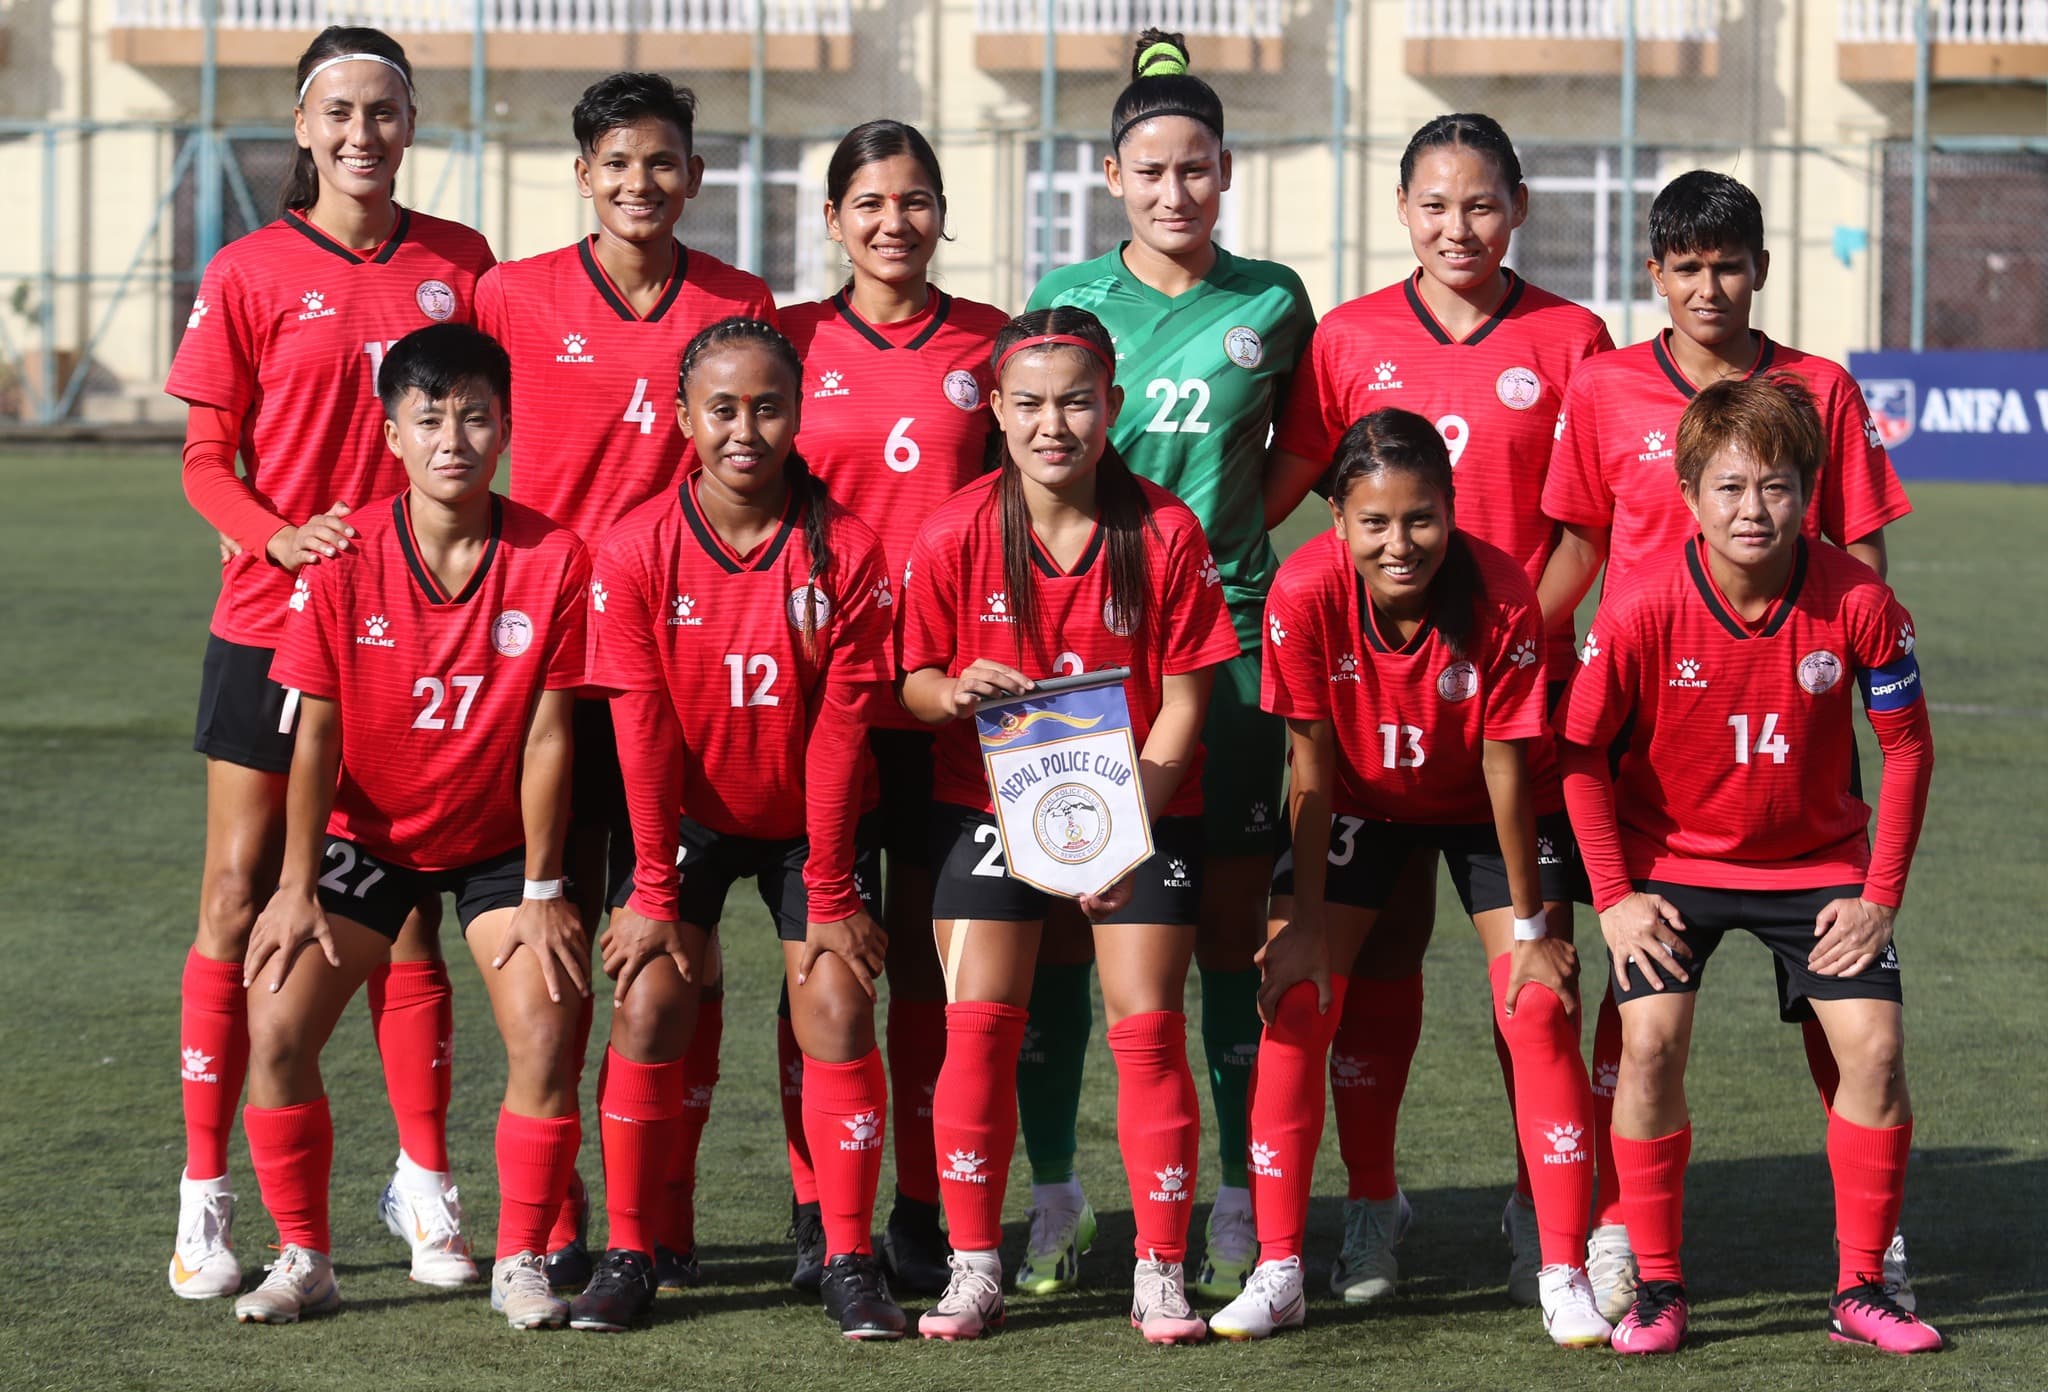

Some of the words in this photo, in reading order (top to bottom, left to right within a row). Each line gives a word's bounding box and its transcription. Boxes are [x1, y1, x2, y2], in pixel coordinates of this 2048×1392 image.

[298, 308, 337, 321] KELME
[362, 339, 400, 398] 1
[556, 355, 594, 363] KELME
[623, 379, 656, 434] 4
[814, 388, 850, 398] KELME
[1145, 378, 1211, 434] 22
[1368, 381, 1403, 391] KELME
[1920, 387, 2031, 434] ANFA
[884, 418, 920, 472] 6
[1434, 414, 1469, 470] 9
[1638, 449, 1673, 462] KELME
[357, 637, 395, 647] KELME
[667, 616, 703, 626] KELME
[411, 675, 484, 730] 27
[723, 654, 779, 708] 12
[1669, 678, 1708, 689] KELME
[1871, 670, 1918, 696] CAPTAIN
[1377, 723, 1425, 769] 13
[1727, 713, 1790, 765] 14
[998, 763, 1042, 804] NEPAL
[1040, 750, 1091, 778] POLICE
[1094, 754, 1132, 786] CLUB
[1055, 788, 1082, 797] POLICE
[971, 823, 1006, 878] 2
[1327, 813, 1365, 867] 3
[318, 841, 386, 899] 27
[1164, 879, 1191, 888] KELME
[942, 1170, 986, 1185] KELME
[1247, 1163, 1282, 1179] KELME
